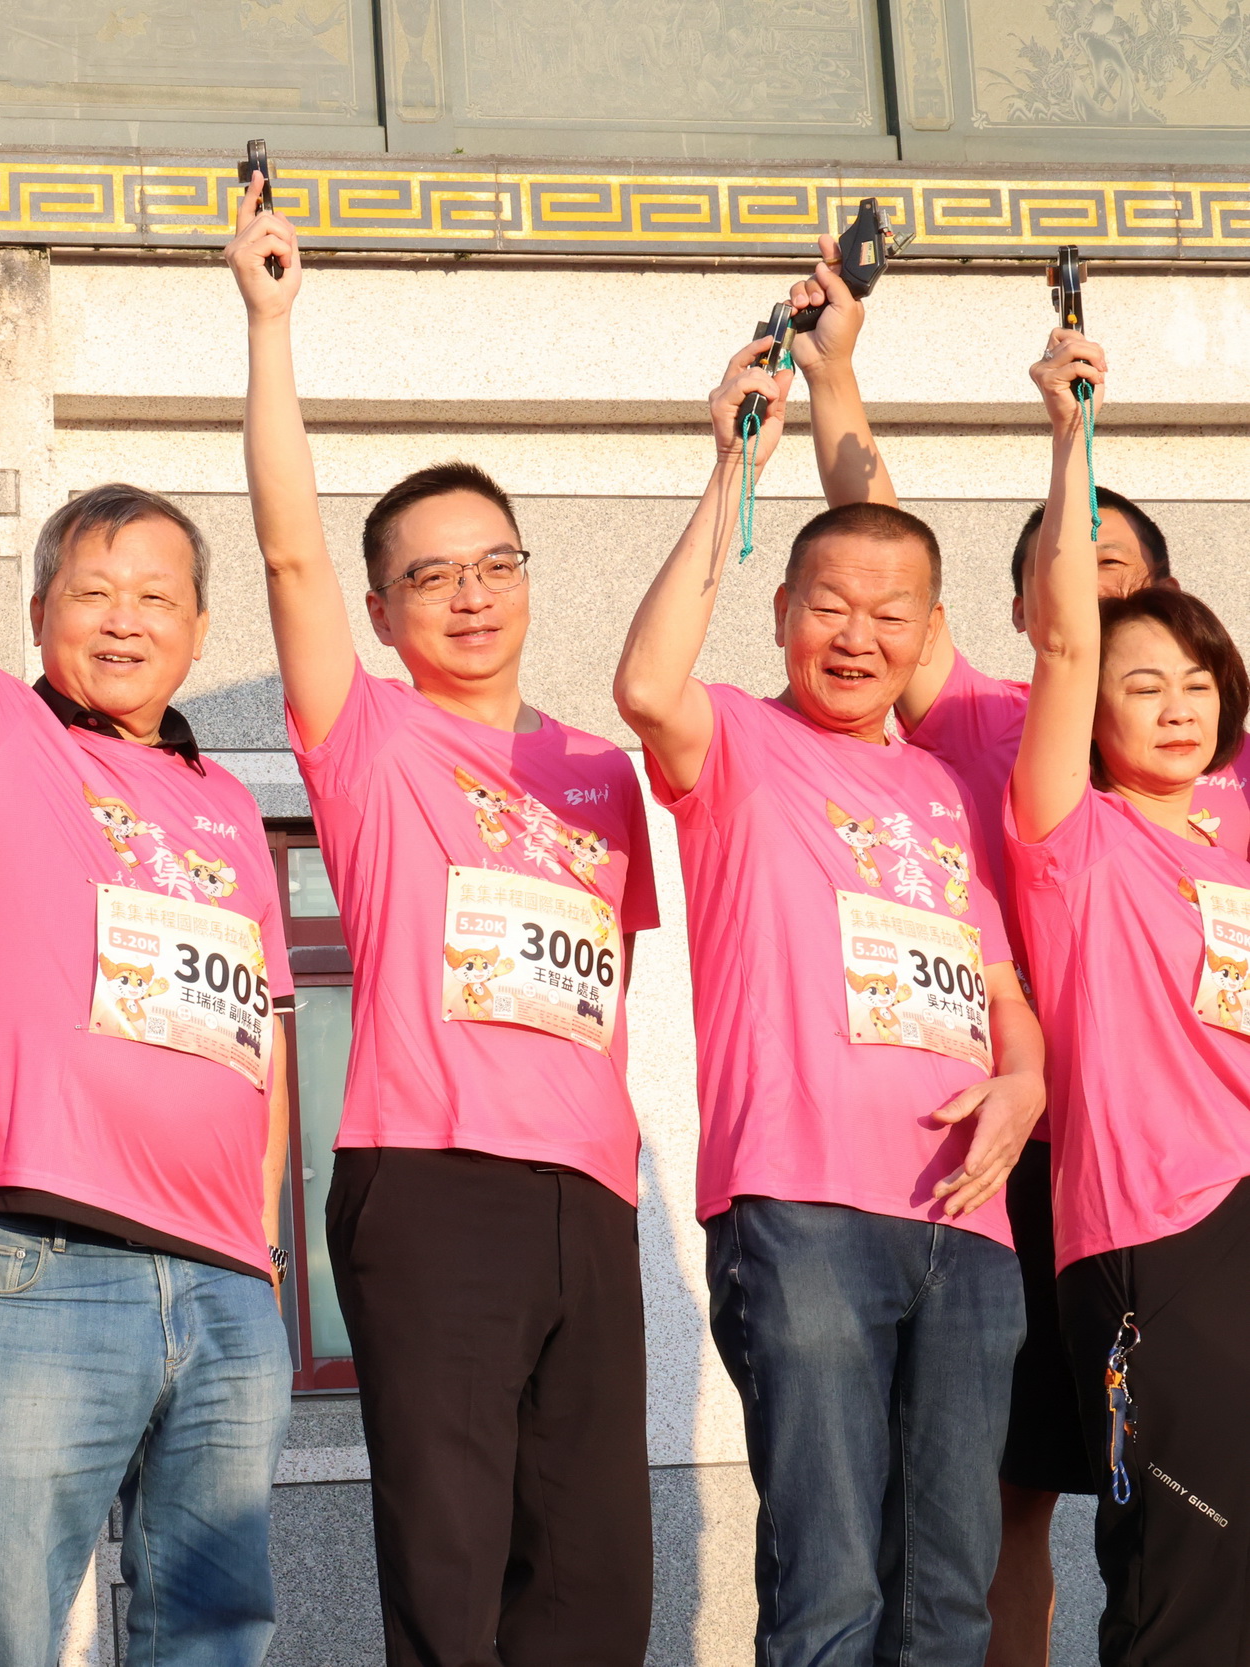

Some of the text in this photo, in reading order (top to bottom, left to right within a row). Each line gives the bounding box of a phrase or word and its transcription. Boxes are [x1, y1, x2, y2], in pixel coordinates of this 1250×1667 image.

[881, 812, 935, 909] 集集
[112, 932, 158, 953] 5.20K
[459, 917, 505, 934] 5.20K
[855, 942, 897, 961] 5.20K
[174, 943, 269, 1018] 3005
[519, 922, 614, 987] 3006
[908, 949, 985, 1012] 3009
[180, 986, 261, 1037] 王瑞德 副縣長
[533, 966, 574, 992] 王智益
[577, 981, 600, 1003] 處長
[1148, 1462, 1228, 1528] TOMMY GIORGIO
